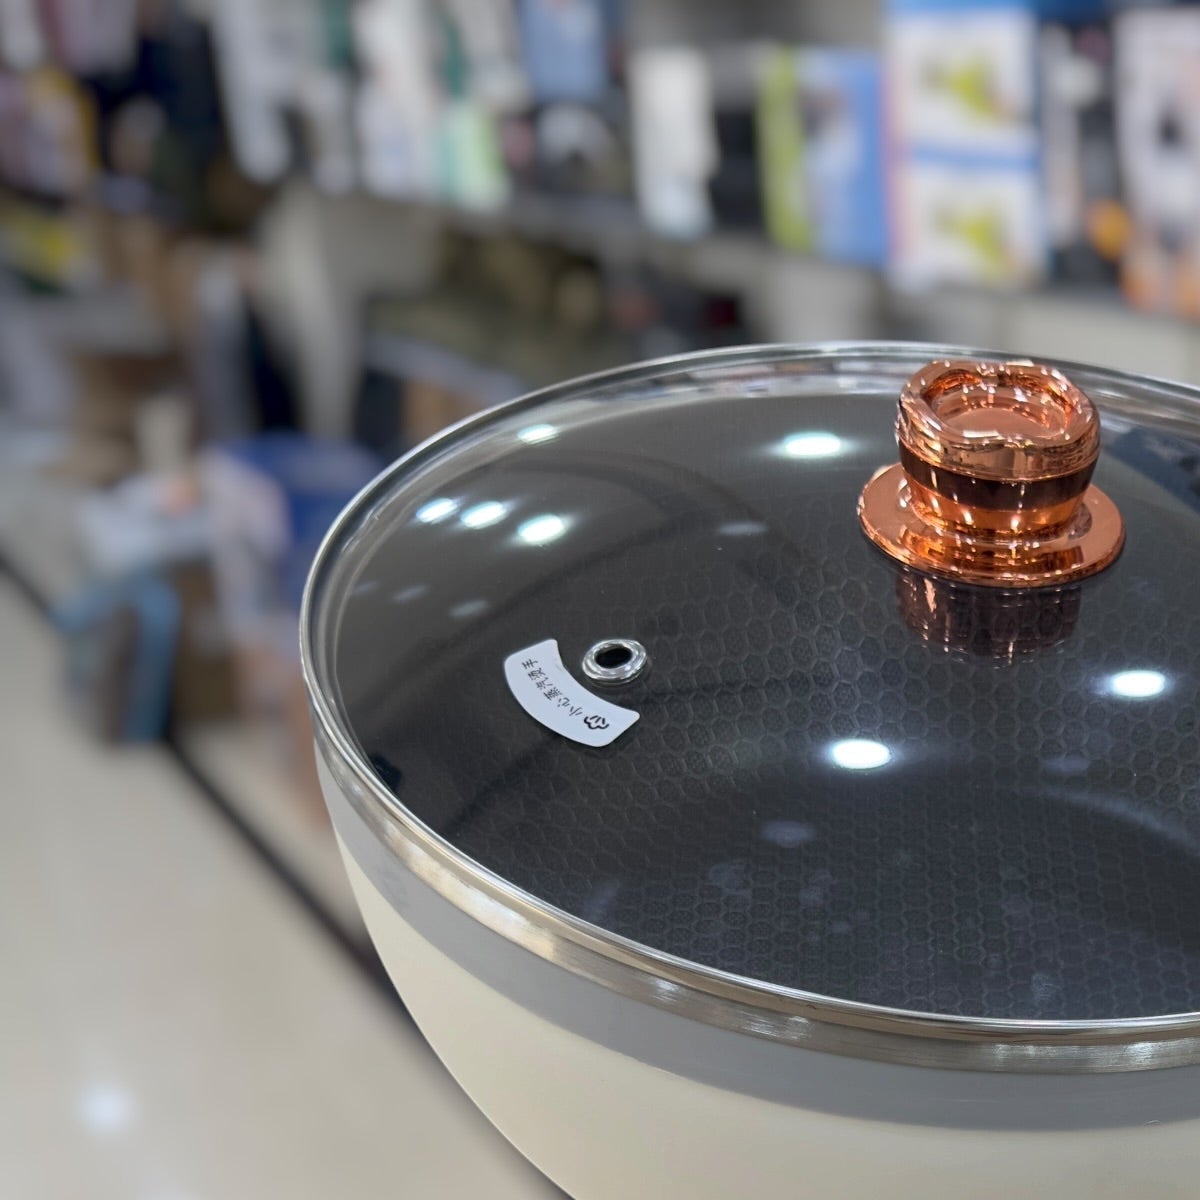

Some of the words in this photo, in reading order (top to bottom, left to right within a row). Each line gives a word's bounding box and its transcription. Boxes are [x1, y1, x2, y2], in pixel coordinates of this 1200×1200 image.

[521, 658, 583, 717] 小心蒸汽烫手
